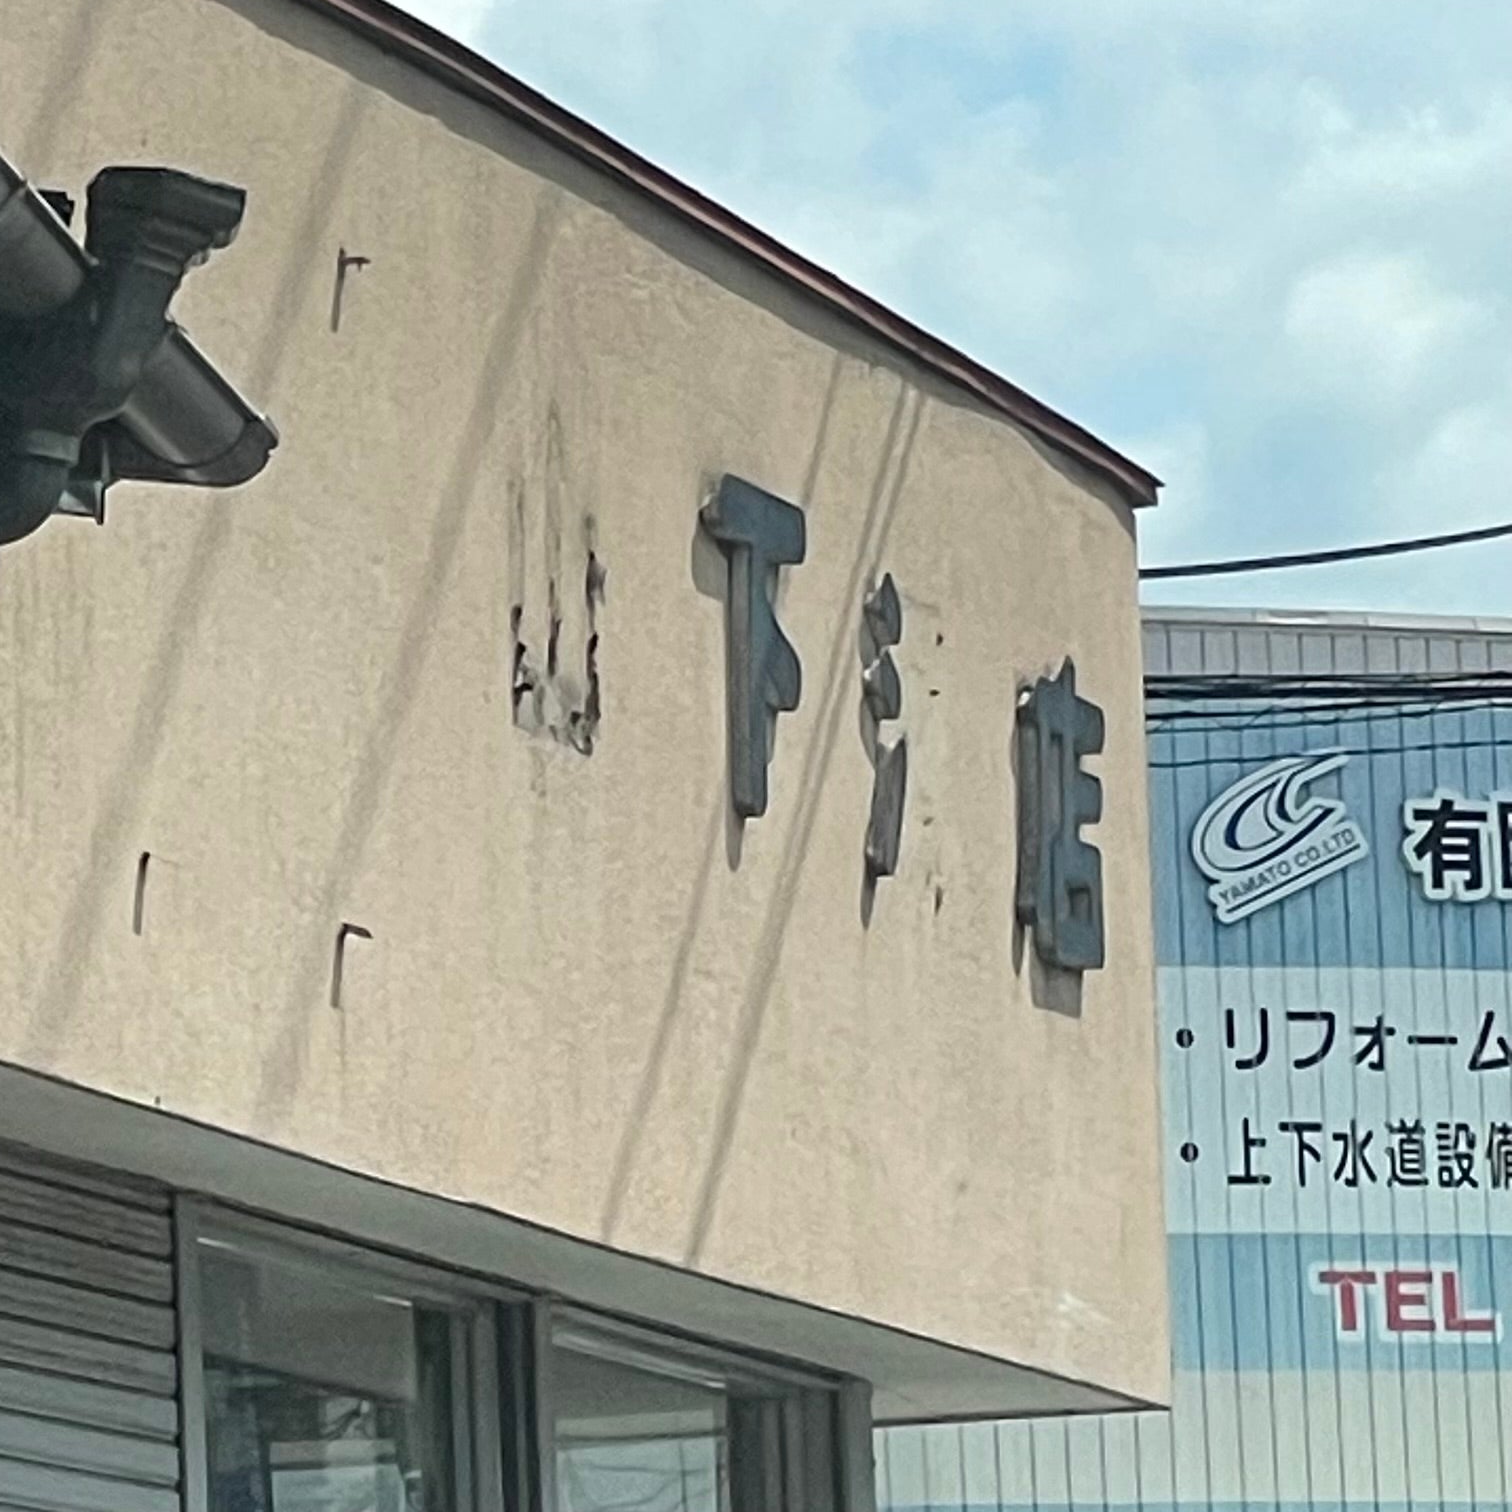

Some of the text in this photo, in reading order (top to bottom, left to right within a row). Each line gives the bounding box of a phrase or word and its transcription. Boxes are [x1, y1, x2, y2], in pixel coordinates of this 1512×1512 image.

[1412, 798, 1512, 892] 有
[1218, 859, 1293, 906] YAMATO
[1318, 1271, 1496, 1332] TEL
